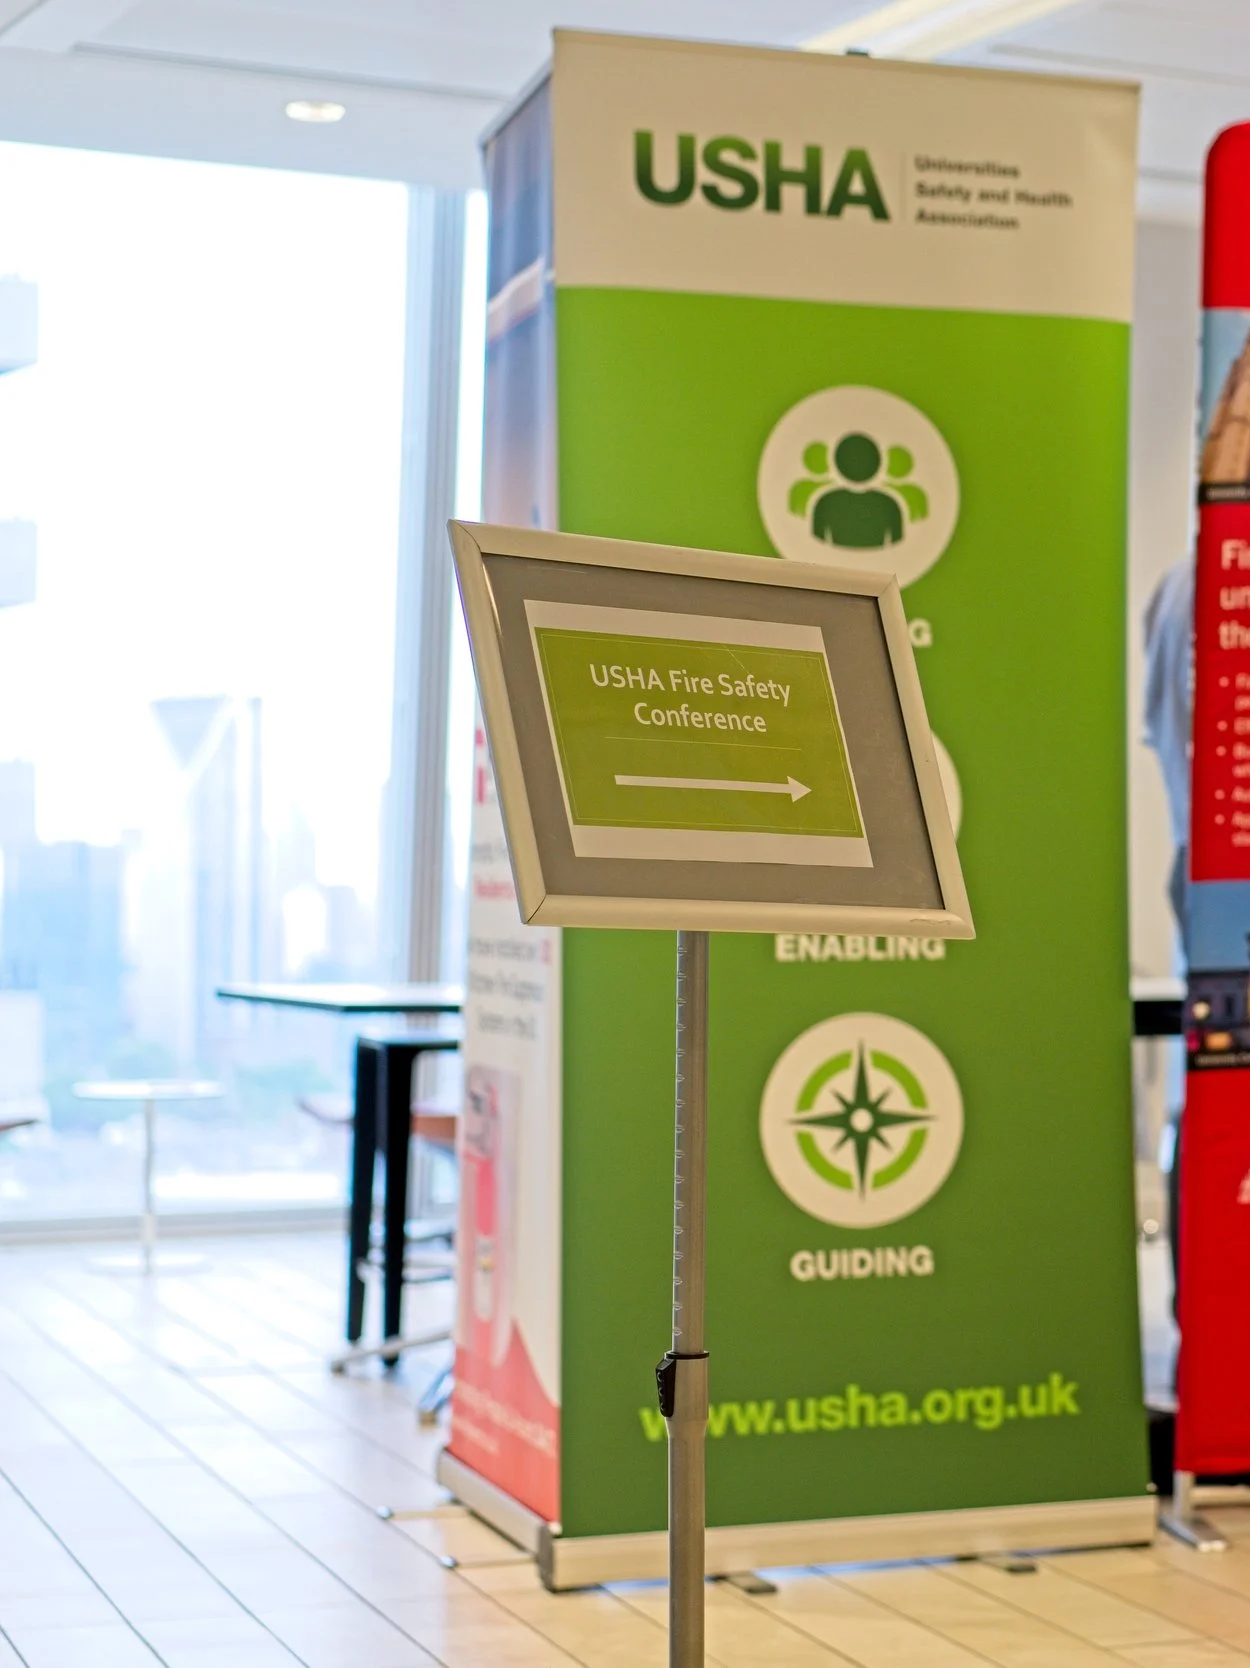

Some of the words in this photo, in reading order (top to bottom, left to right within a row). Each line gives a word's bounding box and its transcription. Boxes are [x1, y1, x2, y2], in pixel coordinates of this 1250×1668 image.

[633, 129, 891, 222] USHA
[914, 155, 1020, 178] Universities
[915, 181, 971, 204] Safety
[977, 187, 1010, 204] and
[1014, 187, 1073, 208] Health
[915, 207, 1020, 230] Association
[589, 663, 665, 691] USHA
[669, 669, 714, 695] Fire
[718, 673, 791, 707] Safety
[634, 702, 767, 733] Conference
[775, 934, 946, 962] ENABLING
[790, 1245, 934, 1281] GUIDING
